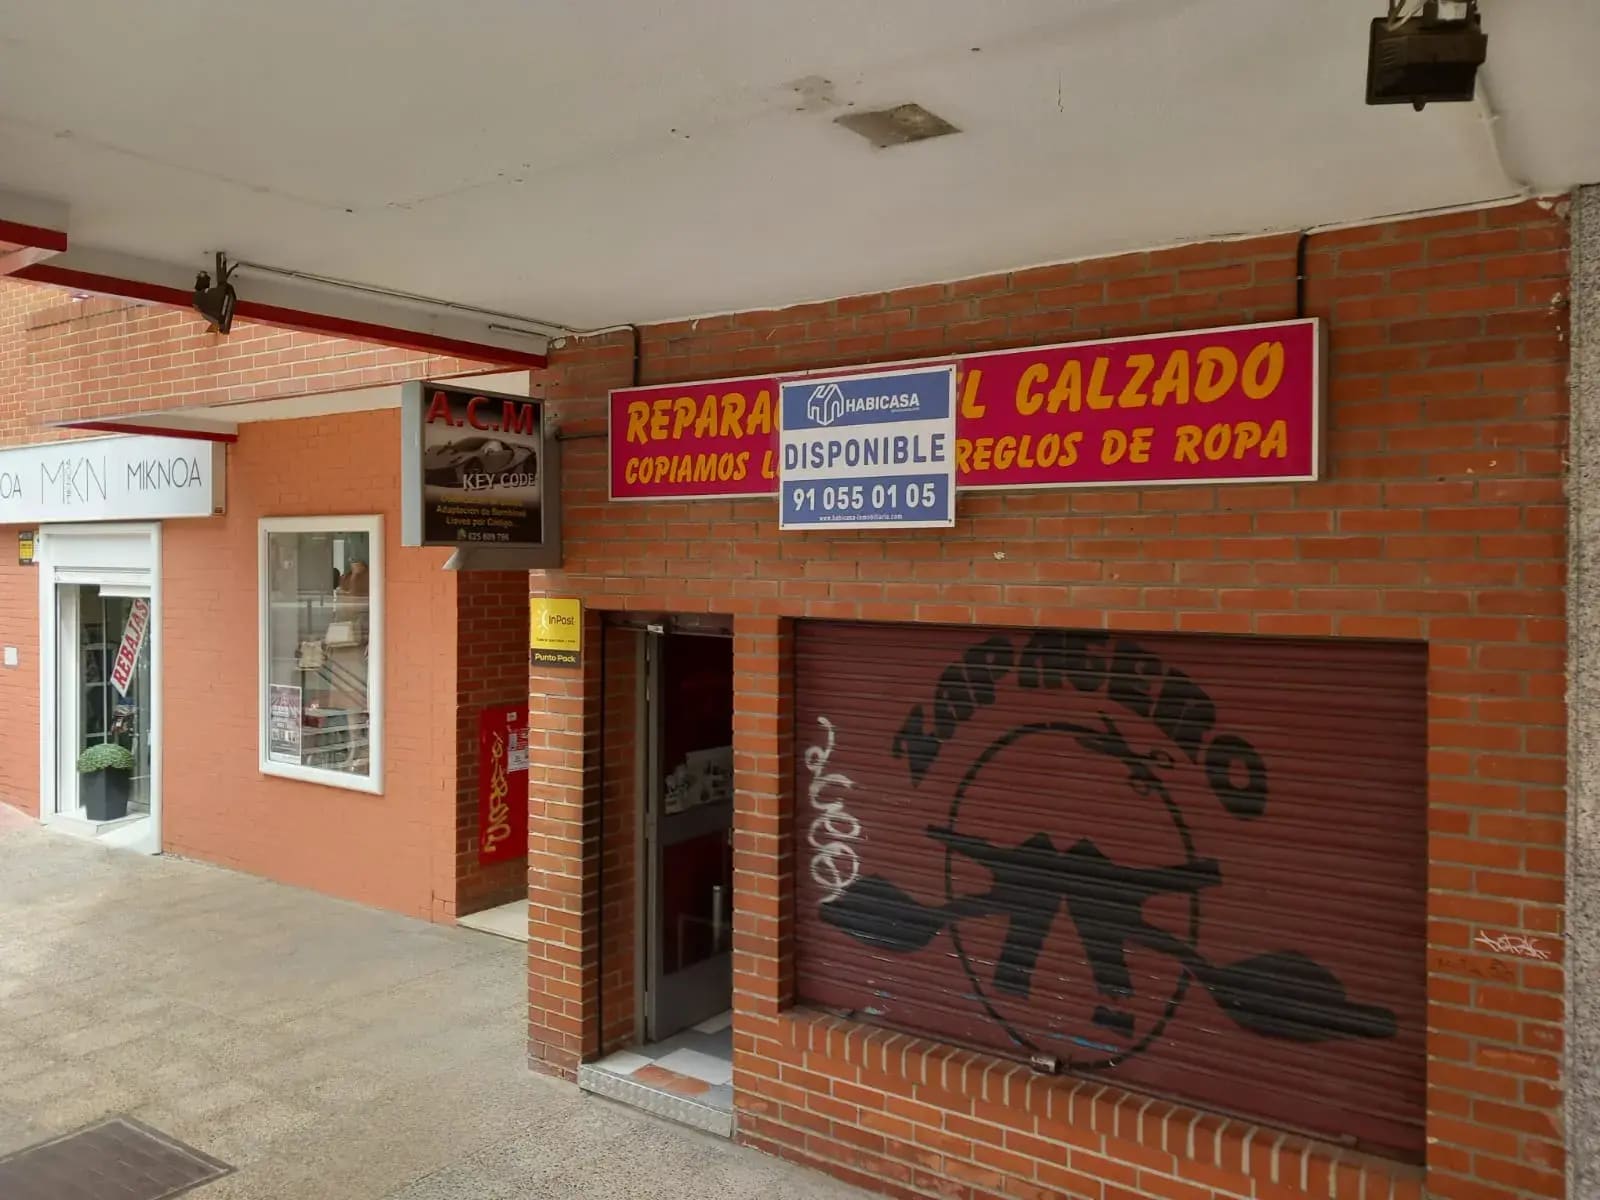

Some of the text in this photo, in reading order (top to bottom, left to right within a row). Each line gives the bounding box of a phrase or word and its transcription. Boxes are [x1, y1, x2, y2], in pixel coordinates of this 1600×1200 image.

[957, 369, 986, 419] L
[1015, 341, 1285, 416] CALZADO
[426, 390, 534, 436] A.C.M
[845, 392, 920, 413] HABICASA
[624, 450, 750, 485] COPIAMOS
[761, 450, 780, 480] L
[1100, 427, 1155, 466] DE
[1173, 419, 1288, 465] ROPA
[784, 433, 946, 471] DISPONIBLE
[127, 456, 202, 492] MIKNOA
[463, 472, 536, 491] KEY CODE
[793, 482, 936, 511] 91 055 01 05
[548, 614, 576, 626] InPost
[113, 599, 149, 690] REBAJAS
[534, 653, 576, 664] Punto Pack
